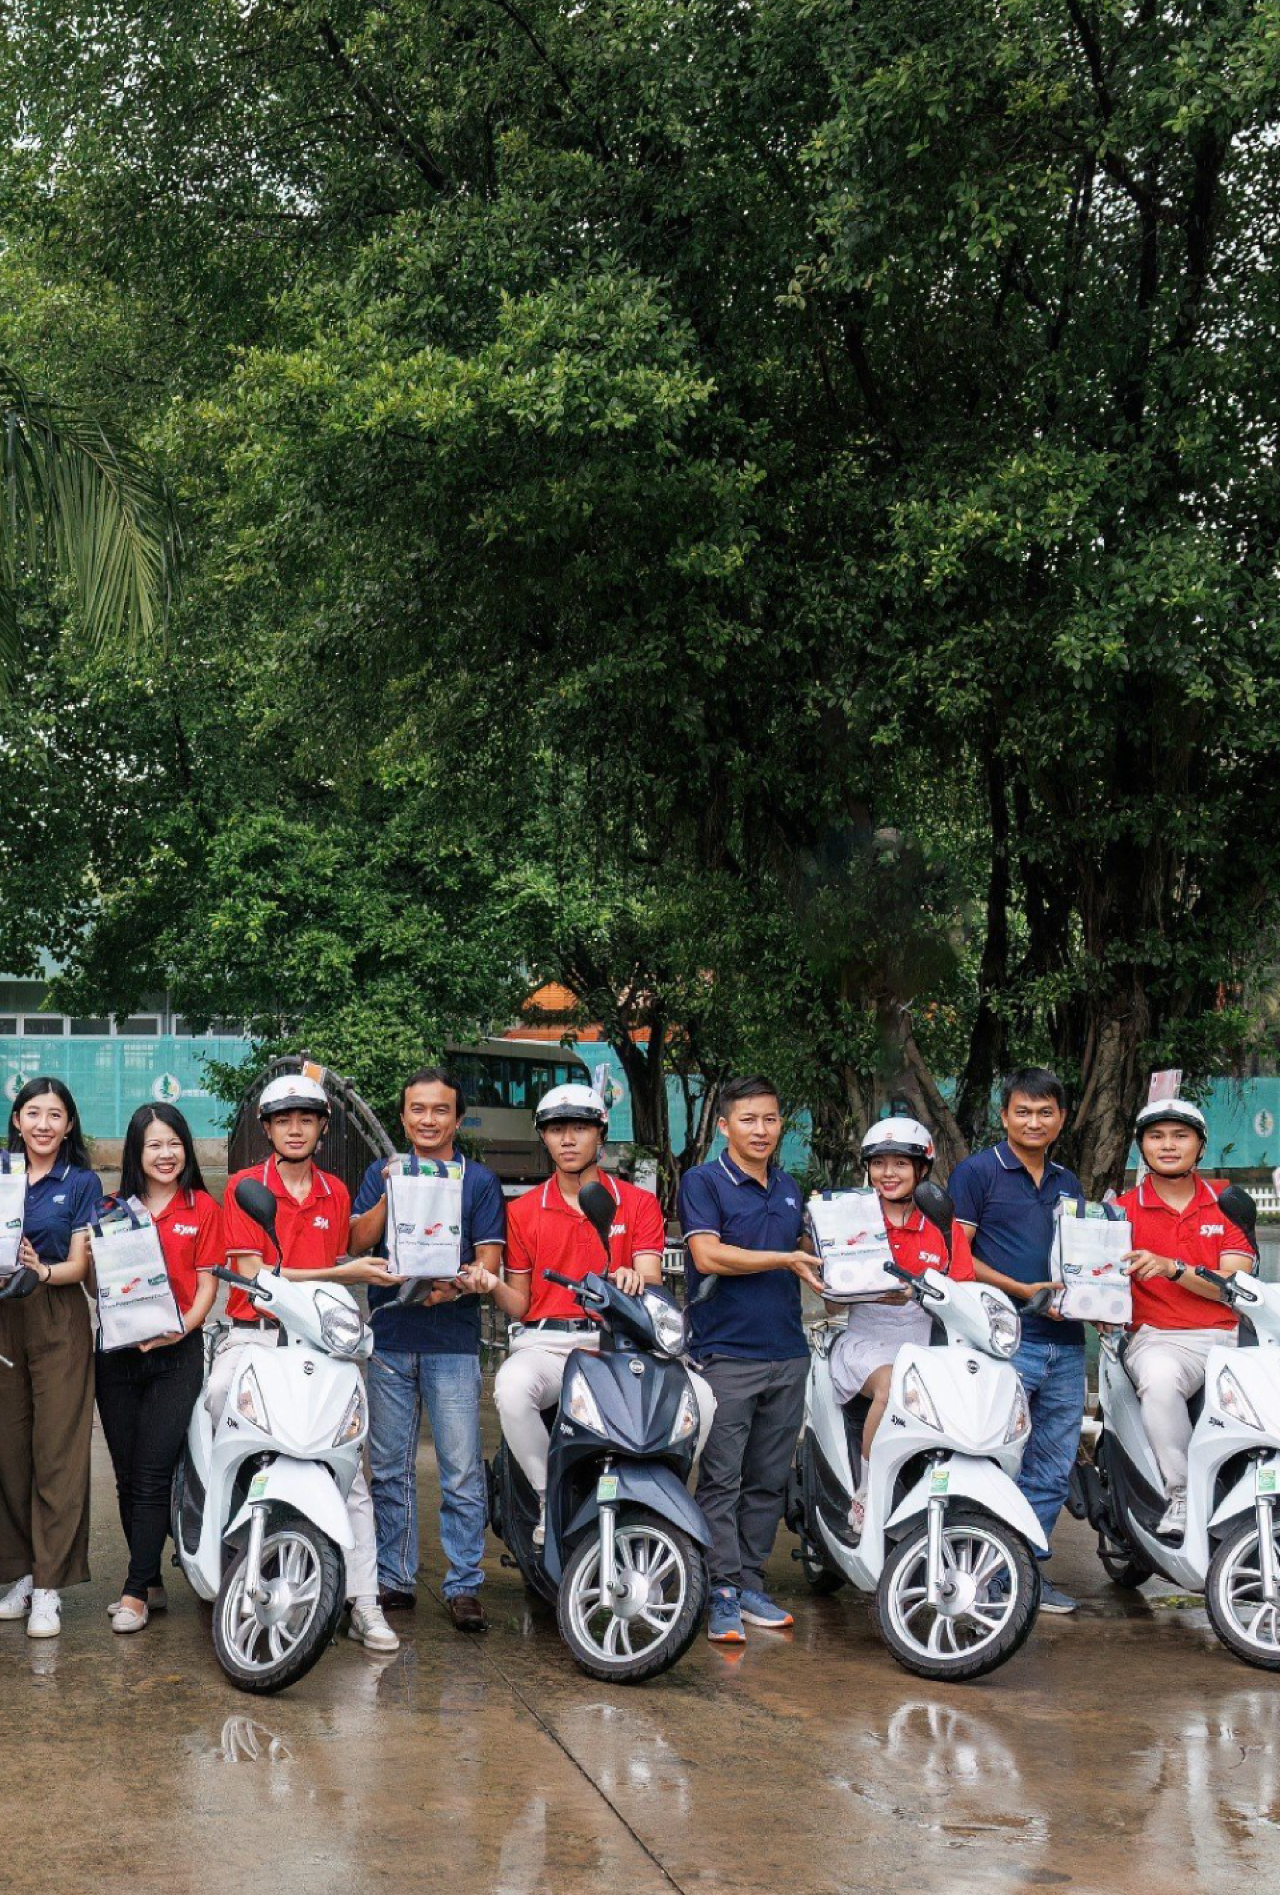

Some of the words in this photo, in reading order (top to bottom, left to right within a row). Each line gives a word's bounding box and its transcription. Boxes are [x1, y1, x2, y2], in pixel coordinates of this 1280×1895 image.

[172, 1223, 198, 1236] SYM
[608, 1224, 627, 1238] YM
[1199, 1224, 1224, 1238] SYM
